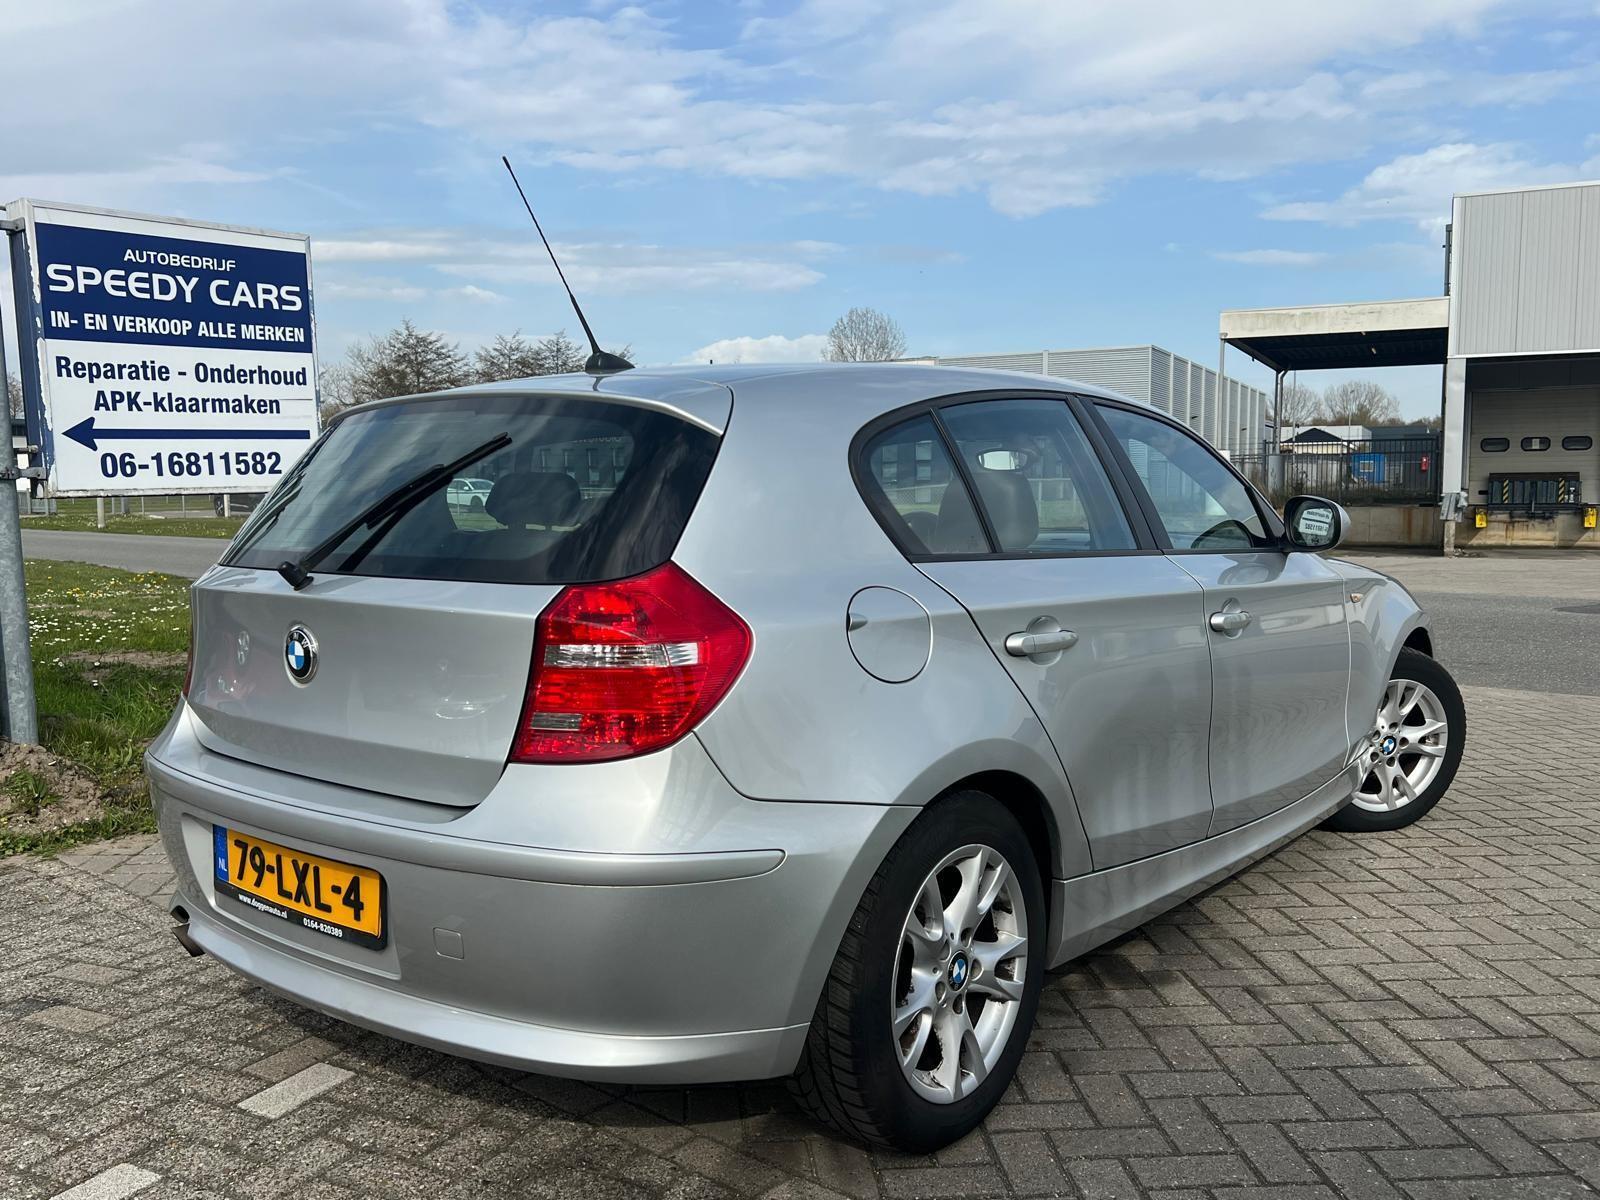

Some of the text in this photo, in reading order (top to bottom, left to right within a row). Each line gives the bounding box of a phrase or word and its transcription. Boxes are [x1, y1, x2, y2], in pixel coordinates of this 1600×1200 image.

[123, 248, 236, 272] AUTOBEDRIJF
[46, 263, 303, 312] SPEEDY CARS
[50, 310, 305, 343] IN- EN VERKOOP ALLE MERKEN
[55, 355, 171, 384] Reparatie
[194, 362, 308, 386] Onderhoud
[94, 390, 281, 414] APK-klaarmaken
[100, 451, 282, 478] 06-16811582
[218, 857, 227, 872] NL
[234, 839, 364, 922] 79-LXL-4
[303, 917, 343, 938] 0164-820389
